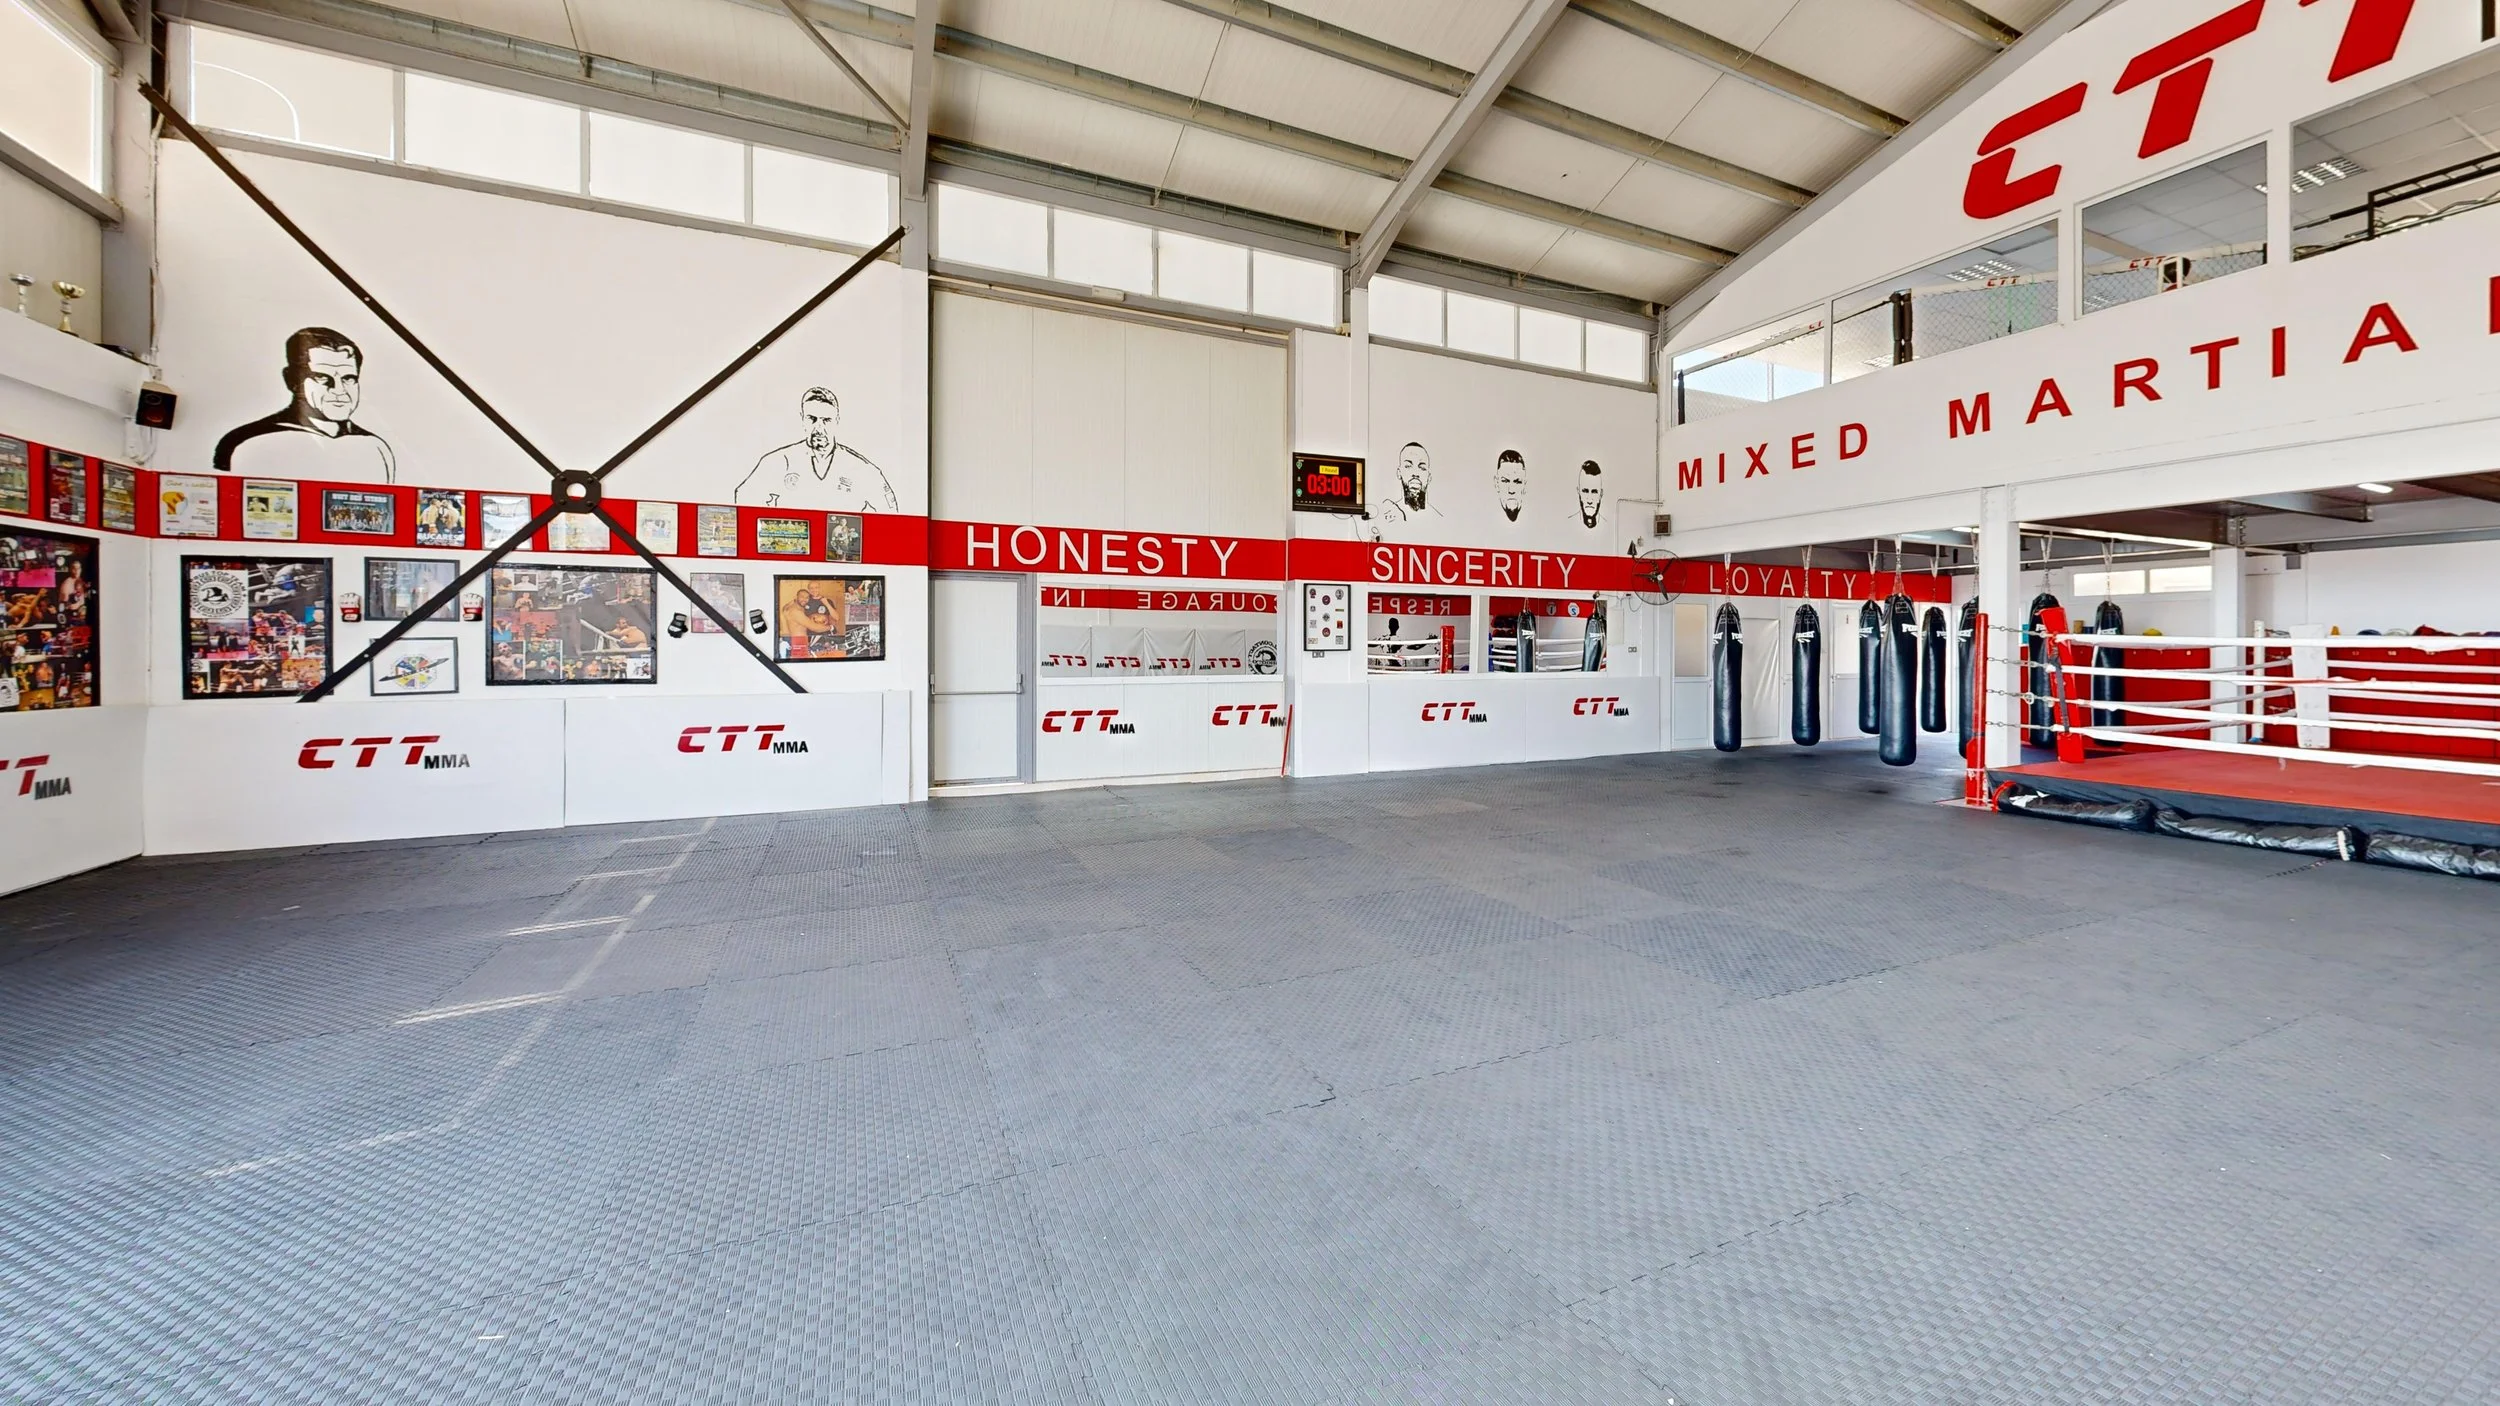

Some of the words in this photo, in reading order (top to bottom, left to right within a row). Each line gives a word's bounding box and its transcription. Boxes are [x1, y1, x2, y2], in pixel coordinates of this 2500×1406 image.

[1986, 275, 2021, 287] CTT
[1678, 422, 1869, 490] MIXED
[1948, 275, 2500, 439] MARTIA
[1307, 473, 1351, 497] 03:00
[966, 525, 1239, 578] HONESTY
[1371, 545, 1577, 588] SINCERITY
[1212, 703, 1278, 726] CTT
[1422, 702, 1476, 721] CTT
[1469, 713, 1488, 723] MMA
[1574, 697, 1620, 715] CTT
[1613, 707, 1630, 717] MMA
[1042, 709, 1119, 733] CTT
[1110, 723, 1136, 735] MMA
[298, 735, 441, 769] CTT
[424, 753, 471, 770] MMA
[678, 724, 785, 753] CTT
[773, 740, 809, 755] MMA
[0, 755, 50, 796] T
[34, 776, 72, 800] MMA
